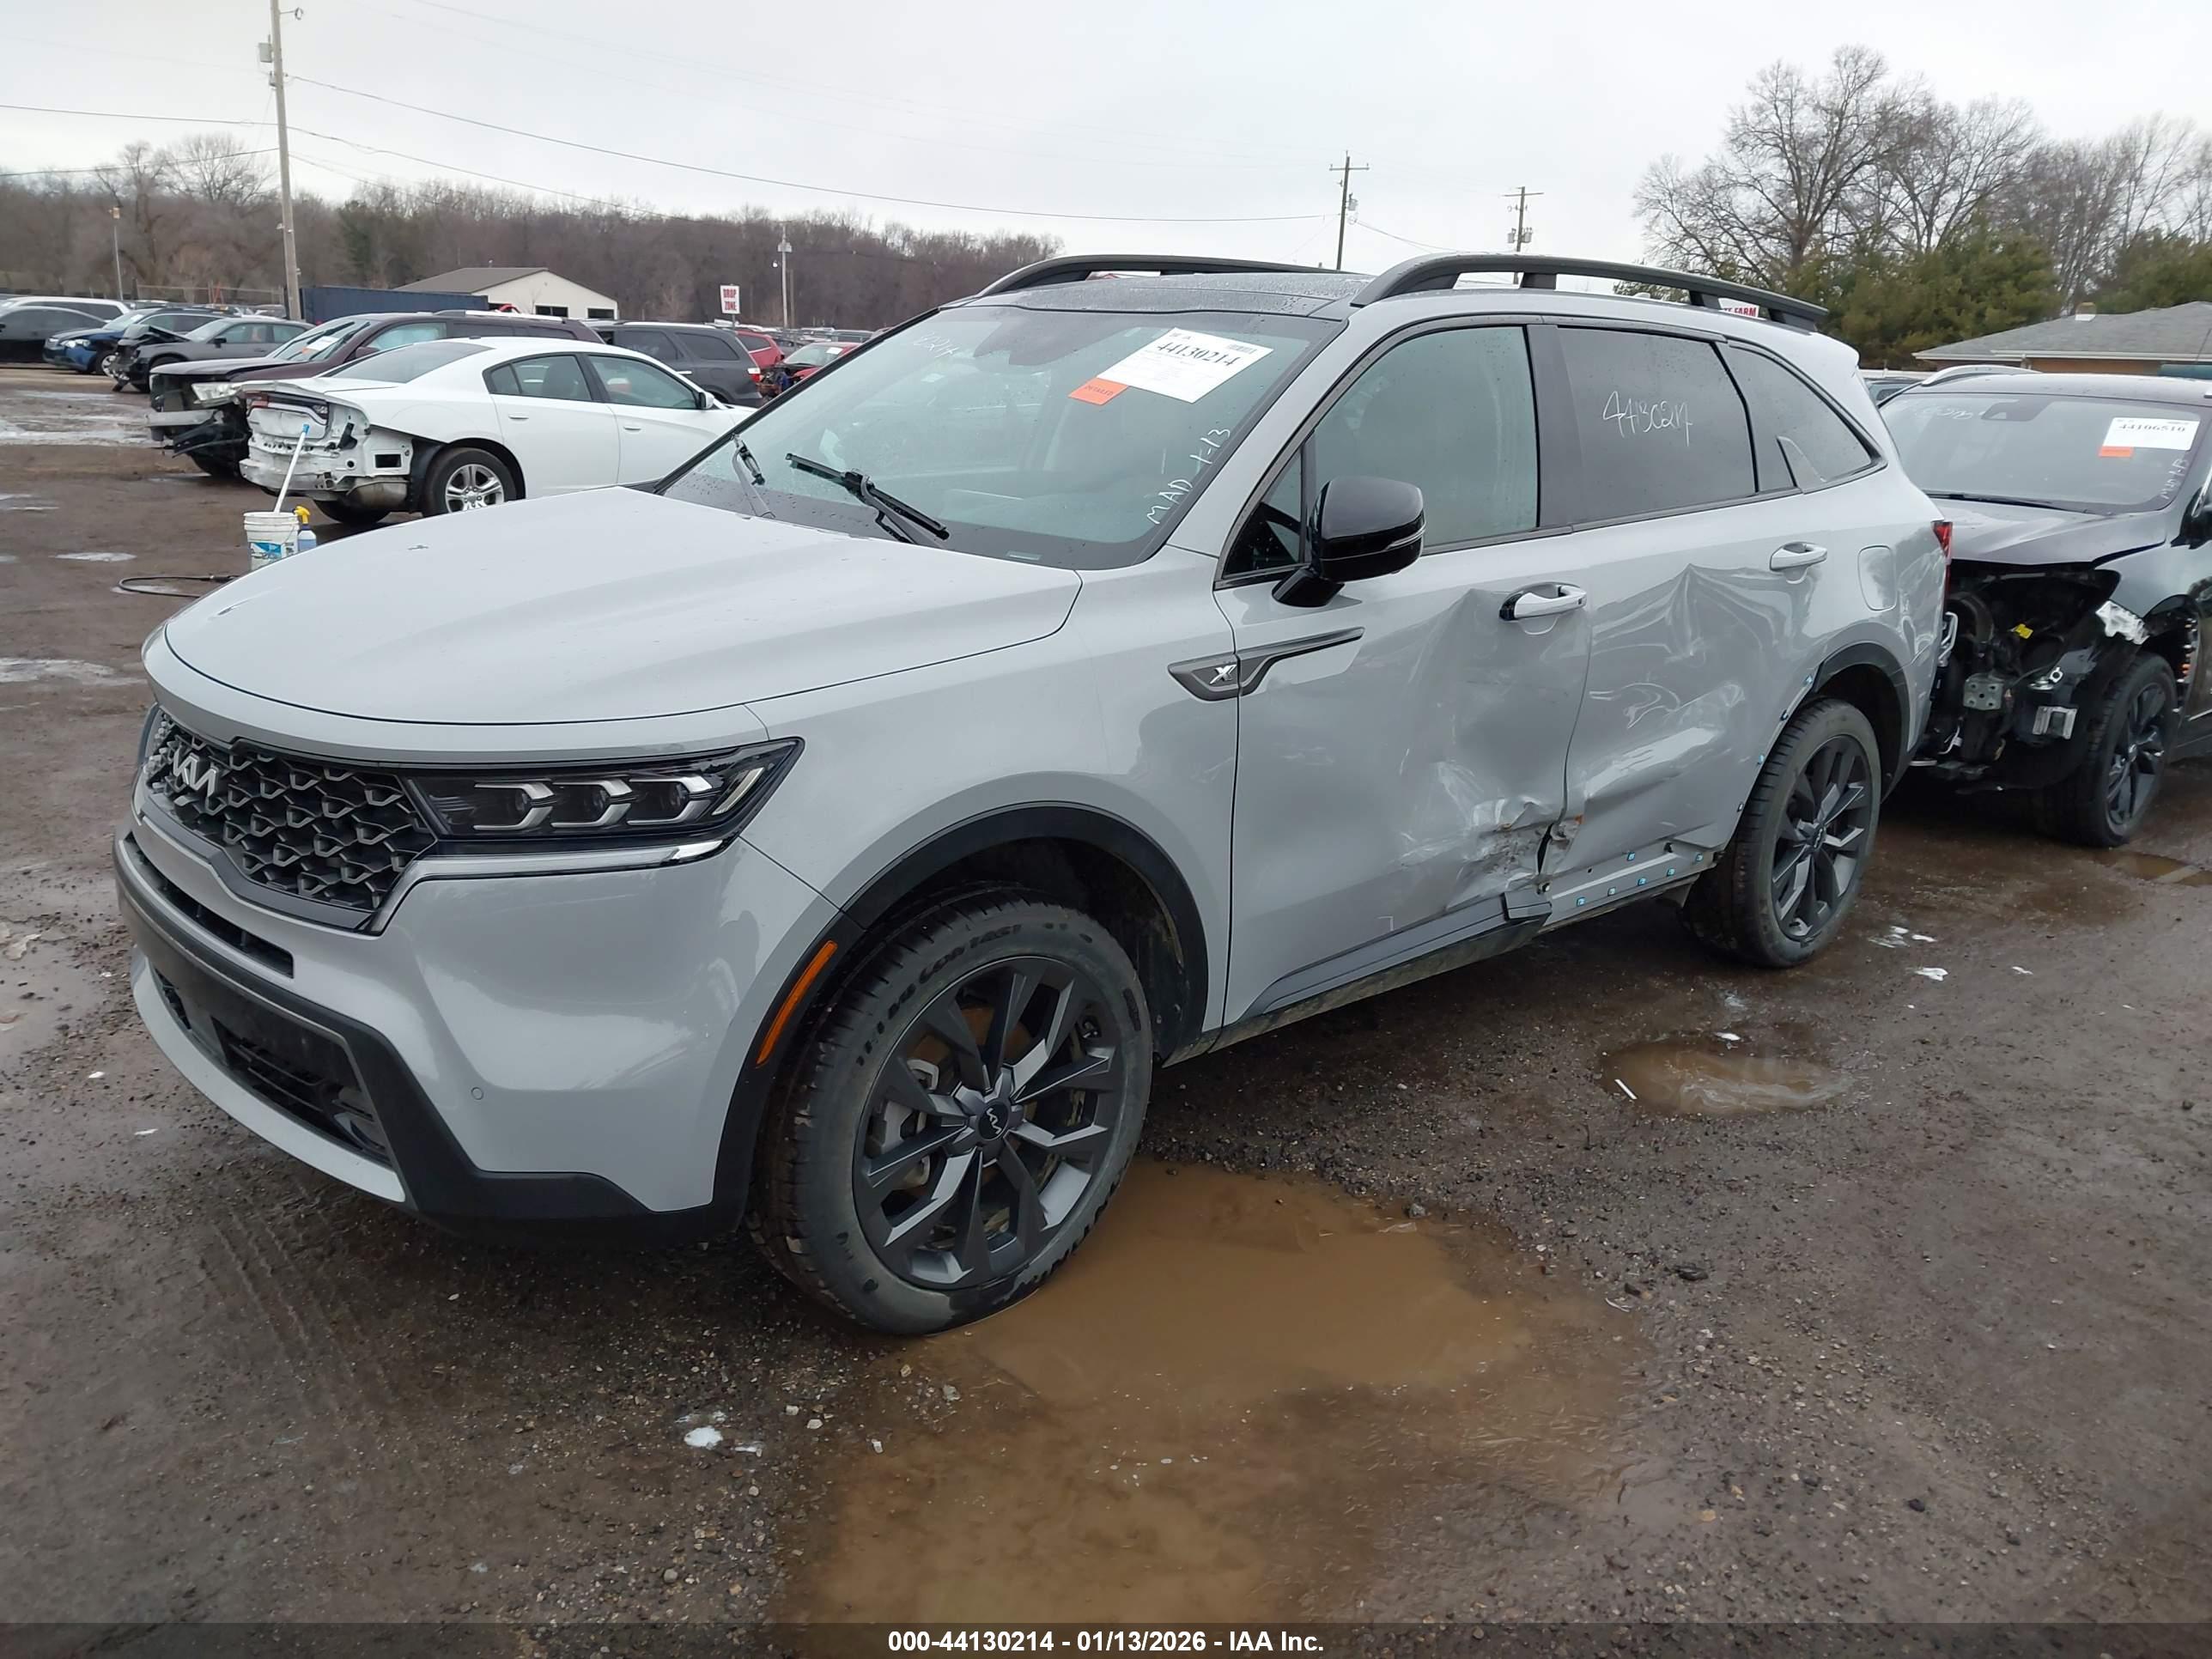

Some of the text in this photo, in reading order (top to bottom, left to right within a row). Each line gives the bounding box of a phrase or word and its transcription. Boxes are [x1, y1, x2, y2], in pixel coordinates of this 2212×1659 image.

[723, 289, 737, 298] DROP
[1158, 342, 1241, 366] 44130214
[1146, 478, 1193, 525] MAD
